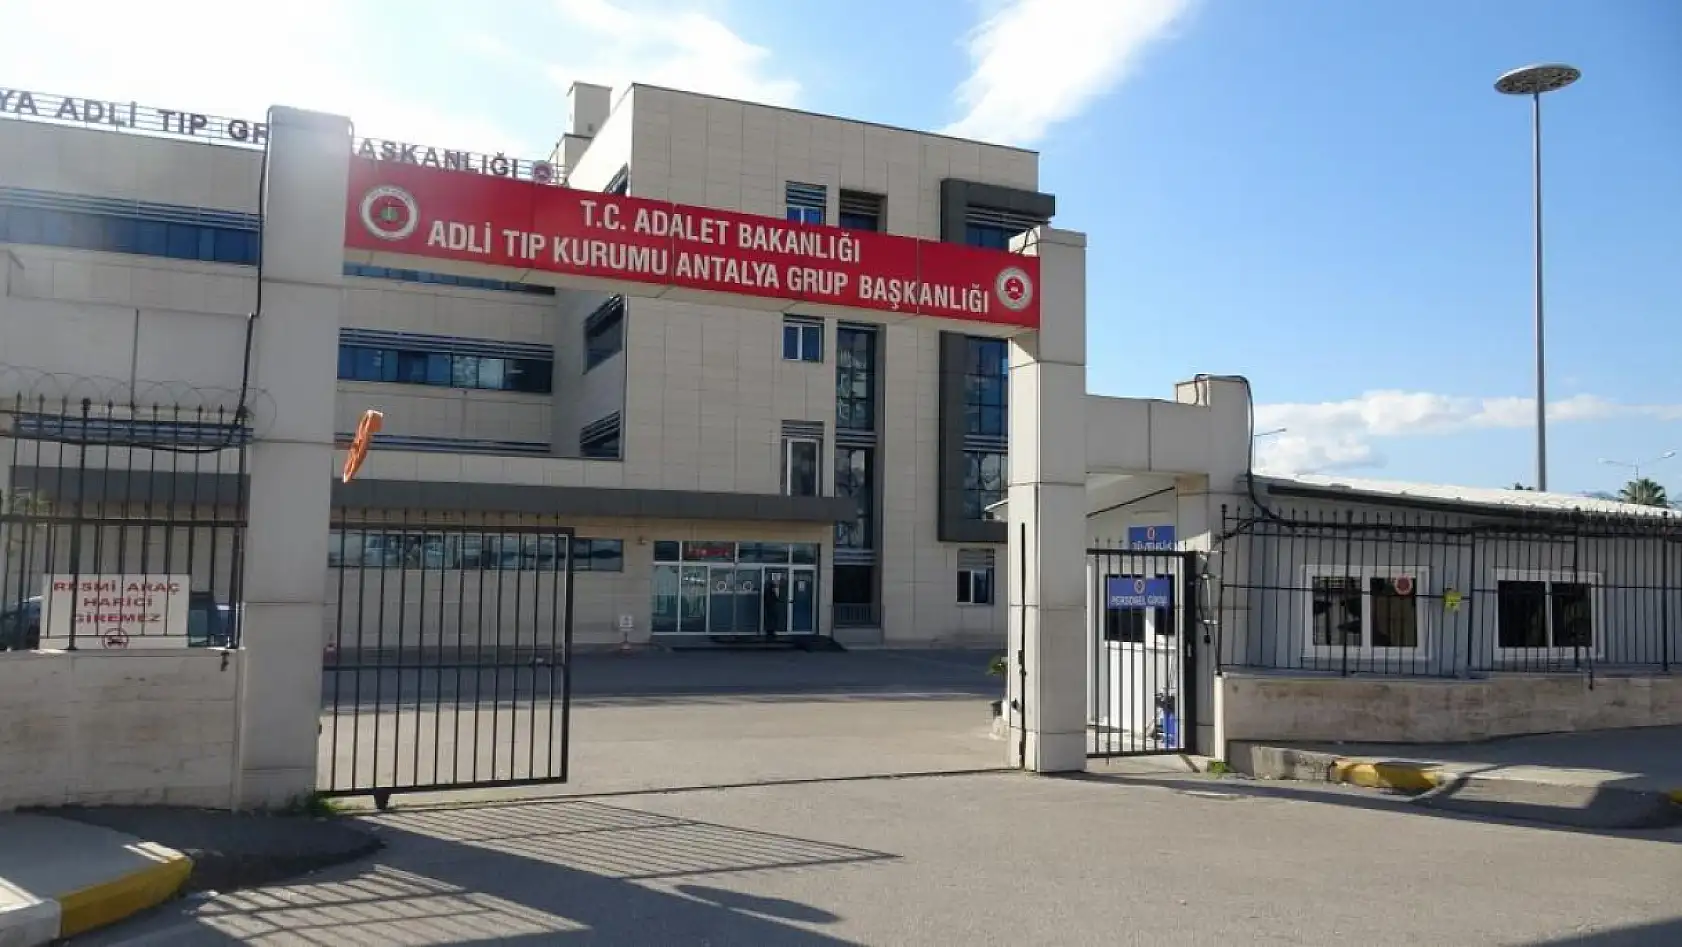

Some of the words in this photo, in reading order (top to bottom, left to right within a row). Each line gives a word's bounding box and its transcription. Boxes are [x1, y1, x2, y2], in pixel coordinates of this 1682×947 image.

[0, 88, 38, 116] YA
[55, 97, 138, 128] ADLİ
[157, 109, 208, 136] TIP
[580, 199, 627, 232] T.C.
[634, 207, 728, 245] ADALET
[737, 221, 860, 264] BAKANLIĞI
[427, 218, 492, 254] ADLİ
[503, 229, 546, 260] TIP
[553, 236, 669, 276] KURUMU
[676, 251, 780, 290] ANTALYA
[787, 266, 848, 296] GRUP
[858, 275, 989, 314] BAŞKANLIĞI
[127, 582, 180, 595] ARAÇ
